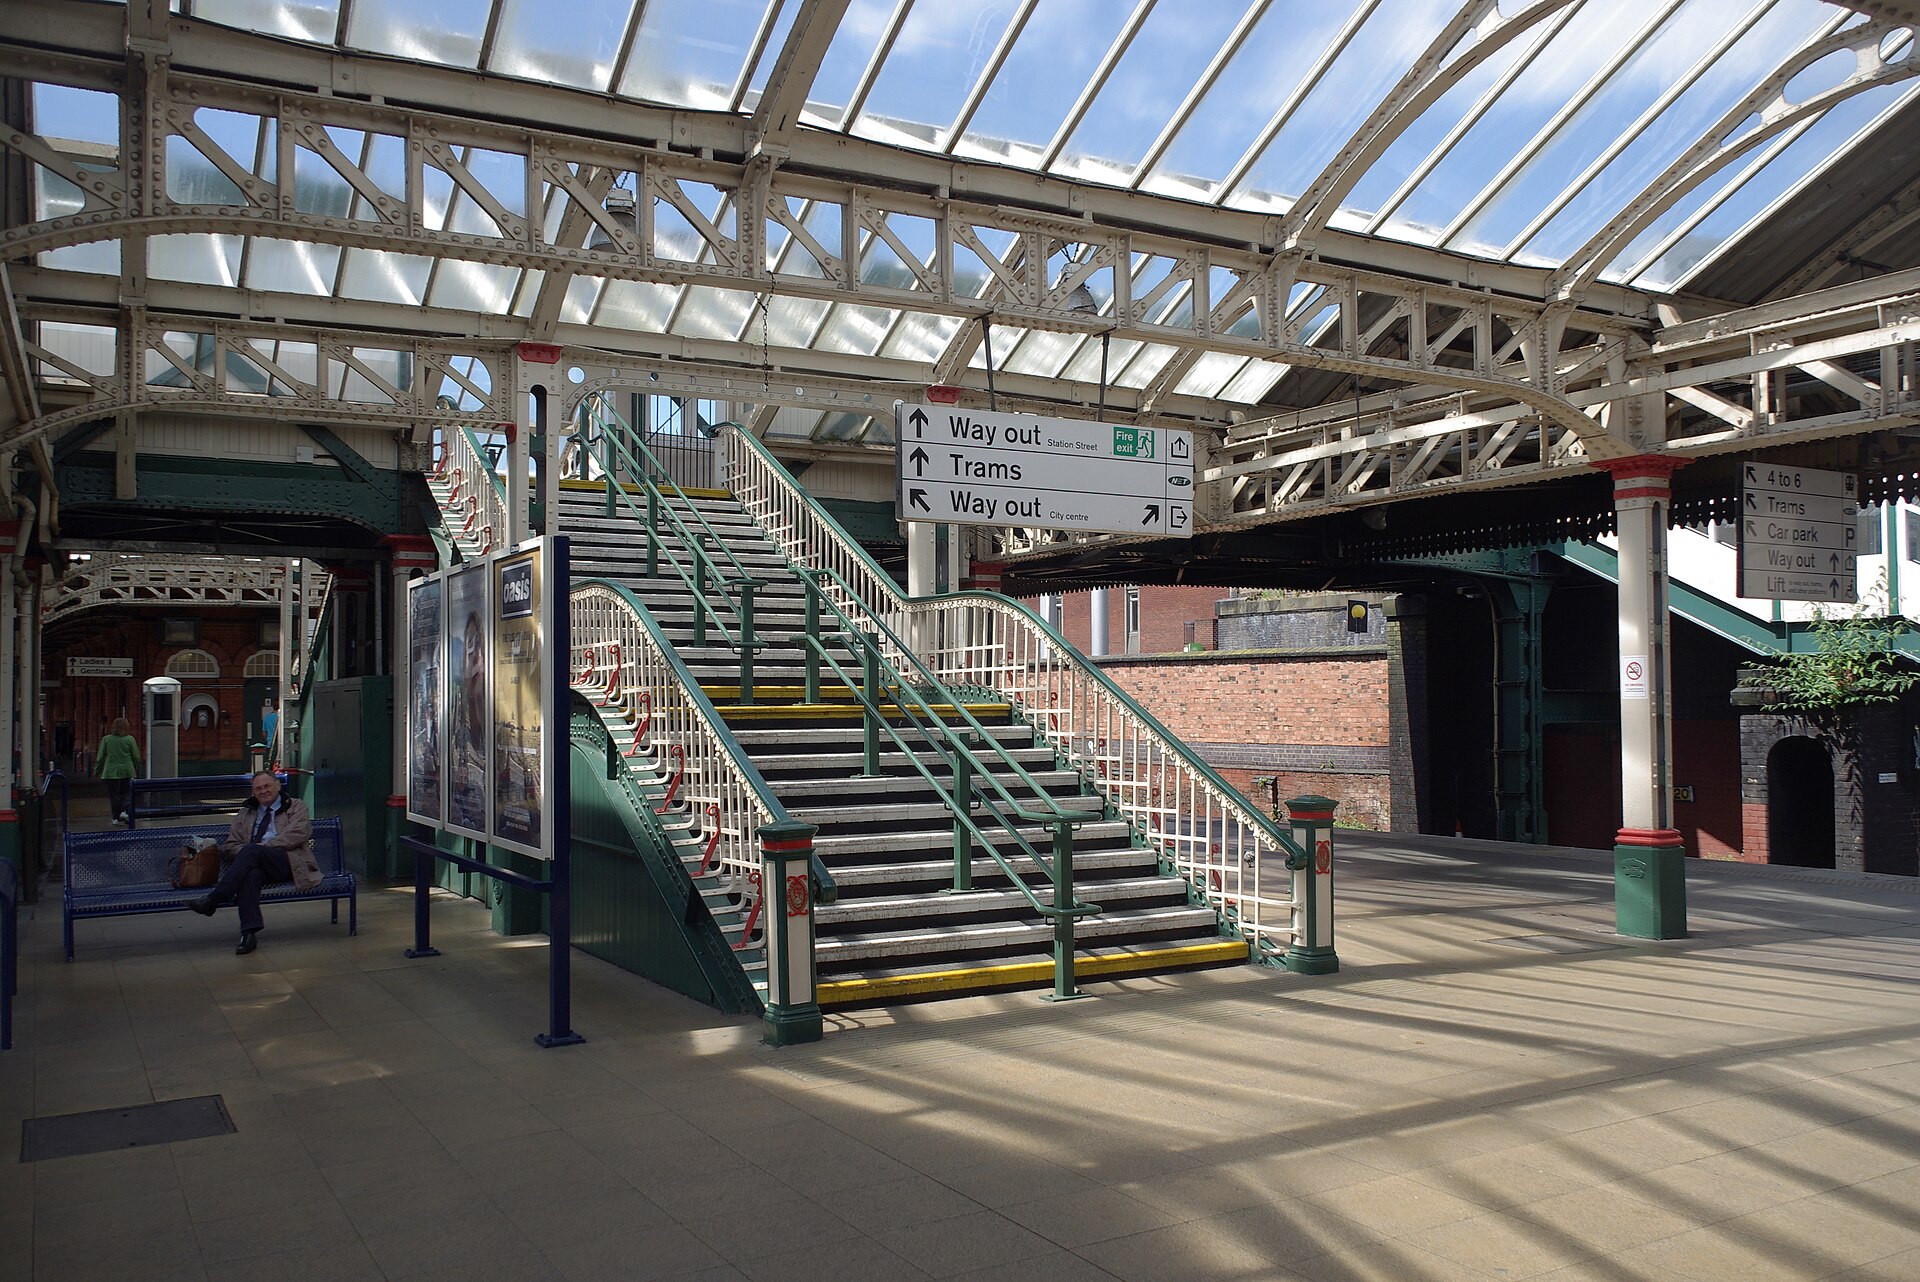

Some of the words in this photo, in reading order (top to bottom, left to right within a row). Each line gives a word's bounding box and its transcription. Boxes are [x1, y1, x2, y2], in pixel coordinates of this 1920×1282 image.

[949, 415, 997, 446] Way
[1004, 425, 1041, 446] out
[1116, 431, 1133, 441] Fire
[1047, 438, 1074, 449] Station
[1075, 441, 1098, 451] Street
[1116, 444, 1133, 453] exit
[950, 454, 1022, 480] Trams
[1767, 470, 1775, 486] 4
[1778, 471, 1790, 487] to
[1794, 473, 1802, 488] 6
[950, 490, 997, 519] Way
[1005, 497, 1041, 518] out
[1767, 496, 1805, 515] Trams
[1049, 511, 1064, 521] City
[1065, 513, 1089, 521] centre
[1767, 523, 1789, 539] Car
[1792, 527, 1818, 544] park
[1845, 528, 1855, 547] P
[1767, 549, 1792, 570] Way
[1796, 553, 1816, 568] out
[503, 572, 530, 604] oasis
[1767, 576, 1785, 592] Lift
[81, 667, 121, 675] Gentlemen
